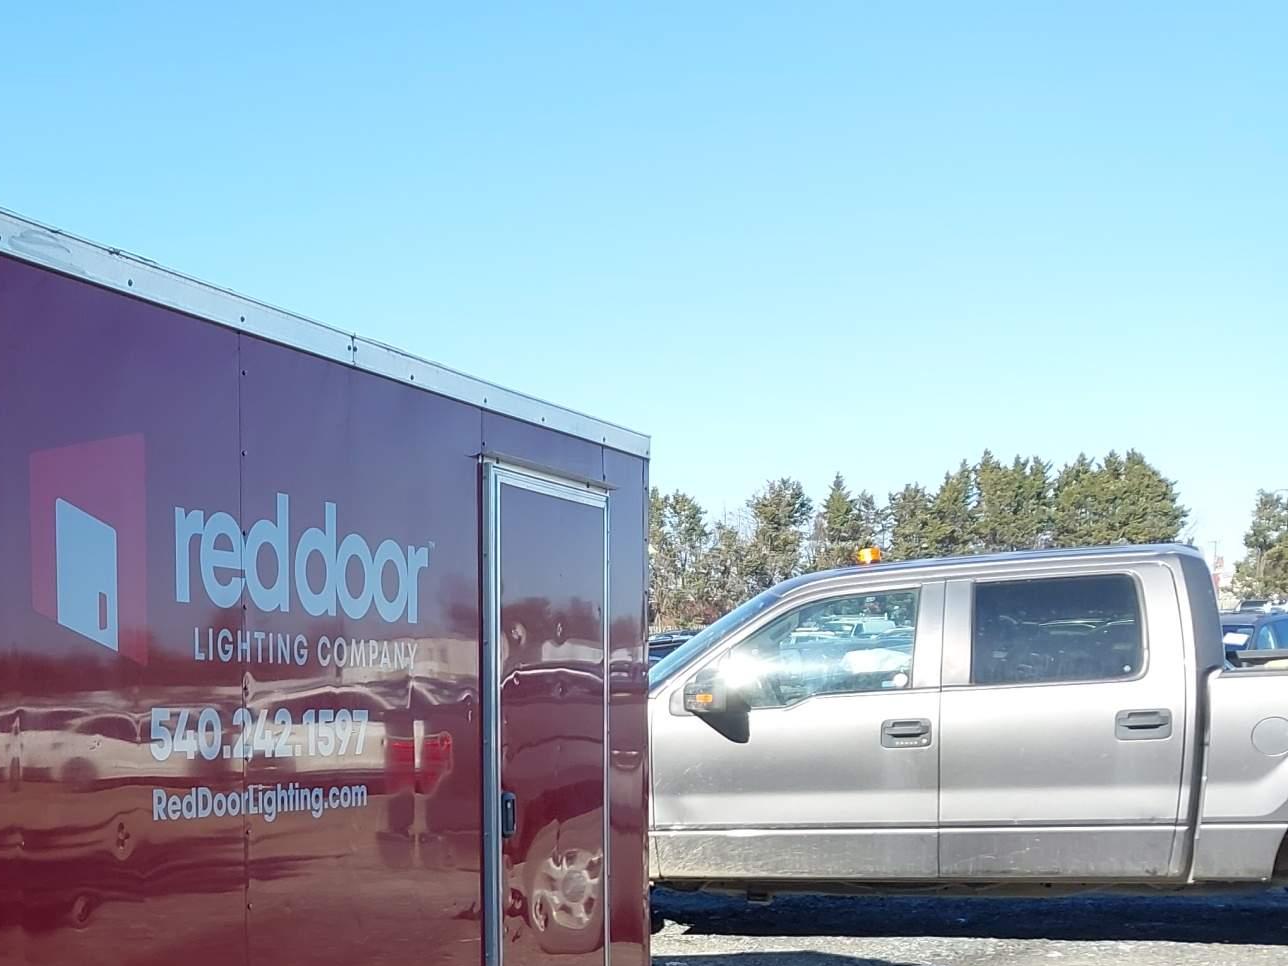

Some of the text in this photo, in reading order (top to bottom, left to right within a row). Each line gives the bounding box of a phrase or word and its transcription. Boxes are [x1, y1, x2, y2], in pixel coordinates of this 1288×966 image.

[193, 627, 418, 670] LIGHTING COMPANY
[149, 707, 370, 762] 540.242.1597
[151, 782, 368, 823] RedDoorLighting.com
